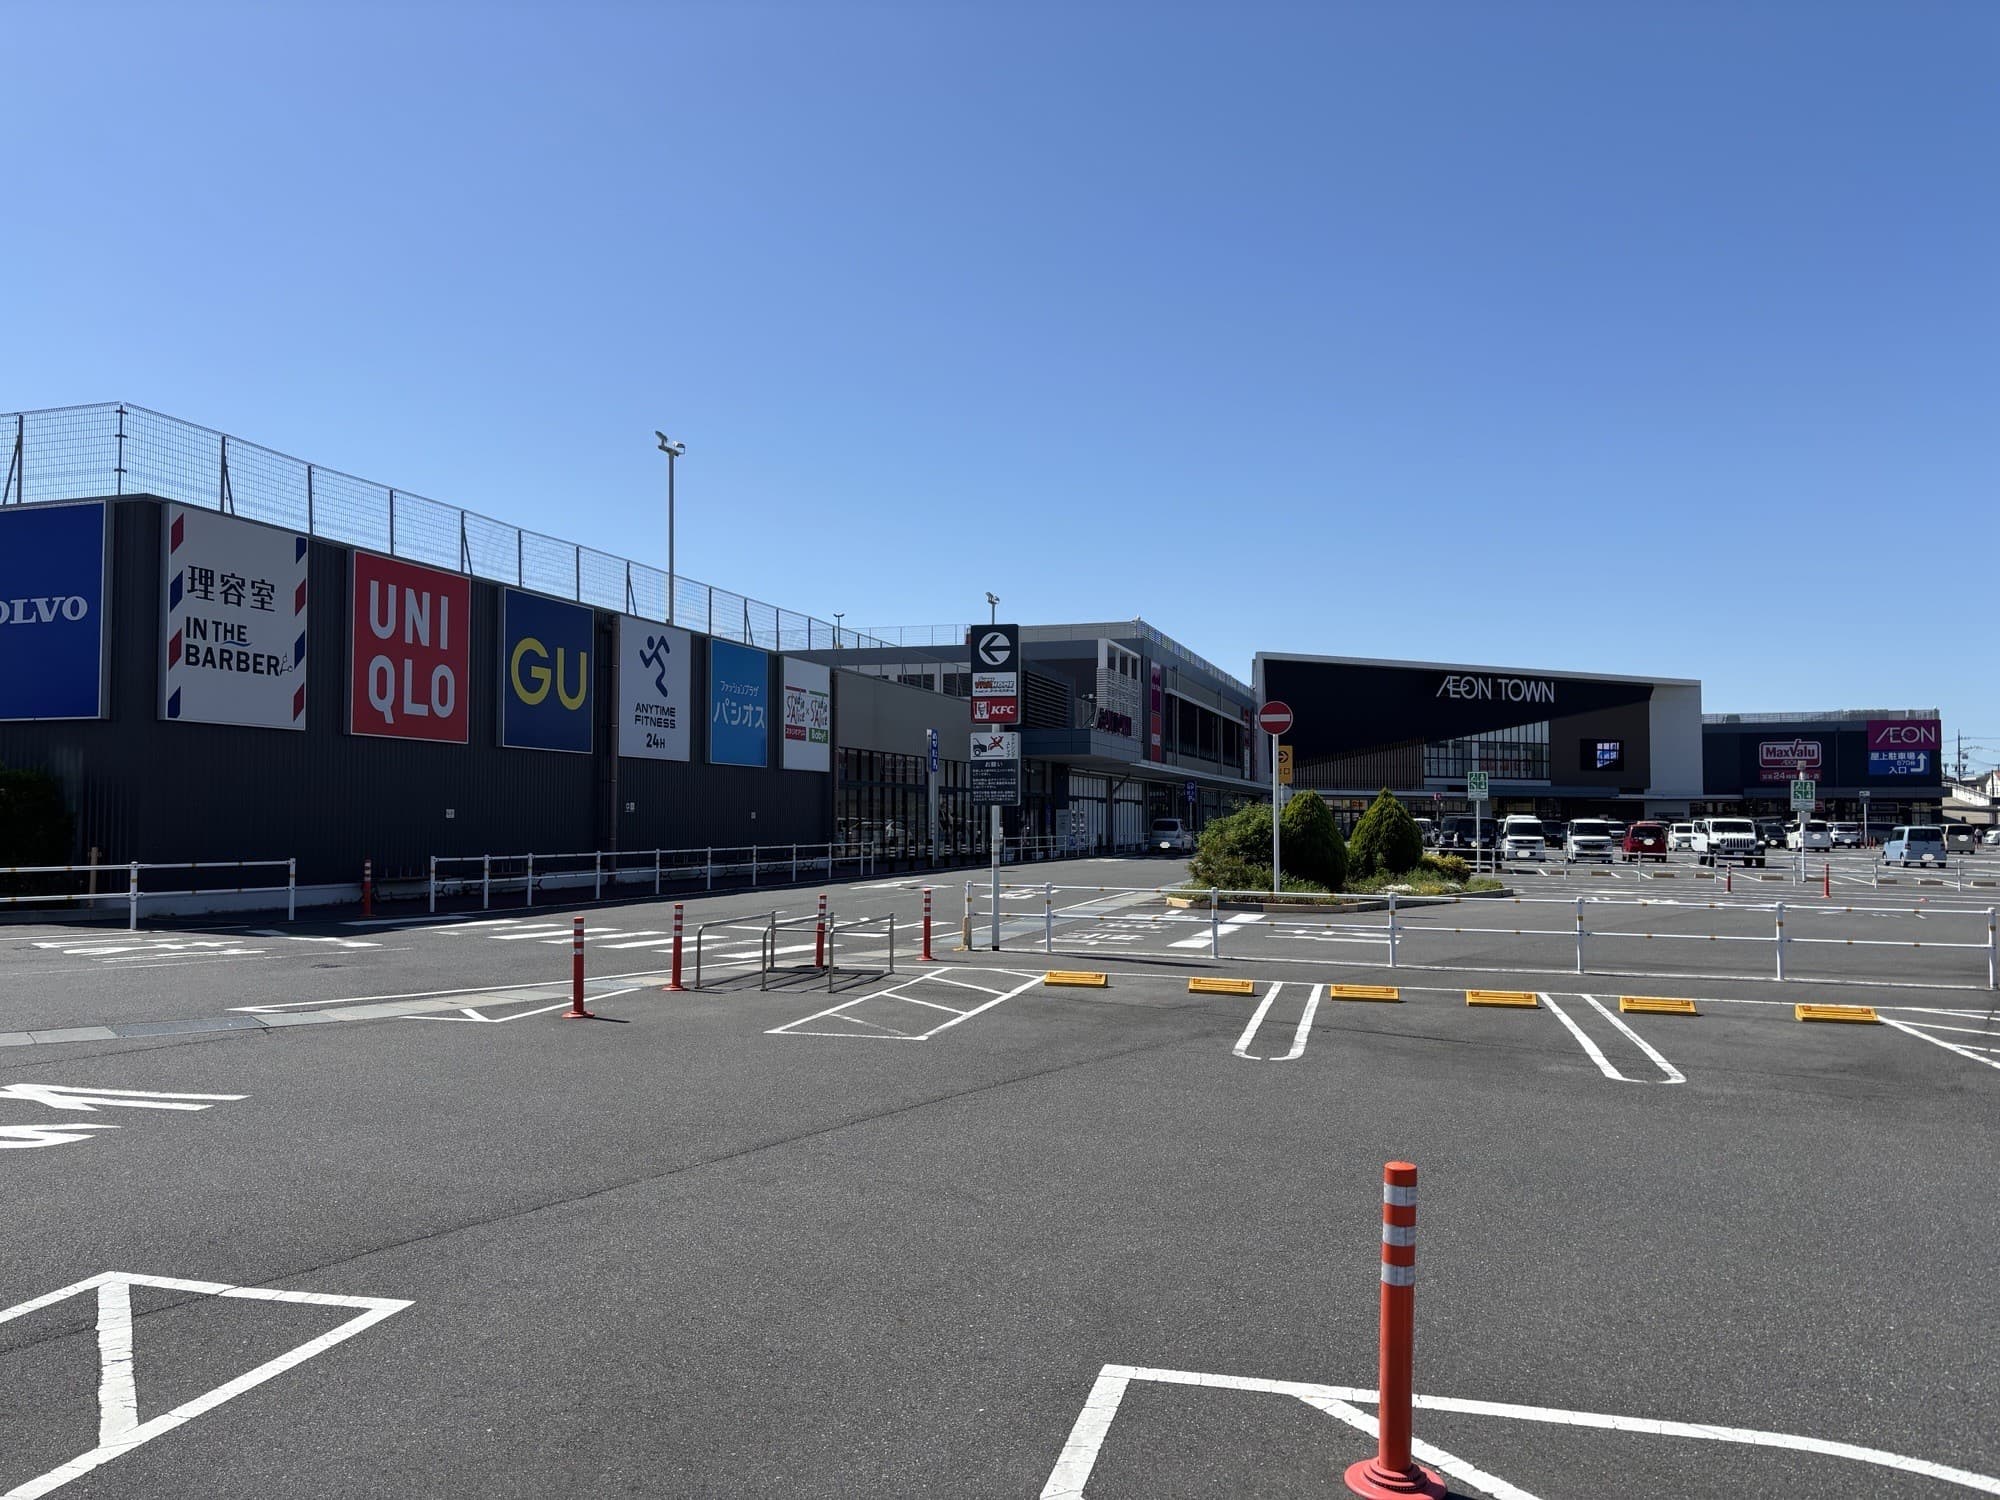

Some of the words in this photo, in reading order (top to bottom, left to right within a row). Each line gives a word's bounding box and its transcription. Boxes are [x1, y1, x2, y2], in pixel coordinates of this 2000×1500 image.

[187, 565, 275, 612] 理容室
[369, 580, 449, 650] UNI
[185, 616, 207, 641] IN
[212, 620, 248, 643] THE
[185, 643, 280, 676] BARBER
[511, 637, 587, 711] GU
[368, 654, 455, 724] QLO
[719, 680, 760, 697] ファッションプラザ
[1497, 678, 1555, 703] TOWN
[635, 702, 676, 717] ANYTIME
[713, 697, 765, 729] パシオス
[991, 705, 1015, 715] KFC
[634, 715, 676, 729] FITNESS
[646, 732, 666, 749] 24H
[1765, 740, 1815, 758] MaxValu
[1870, 752, 1916, 761] 屋上駐車場
[1888, 766, 1907, 775] 入口
